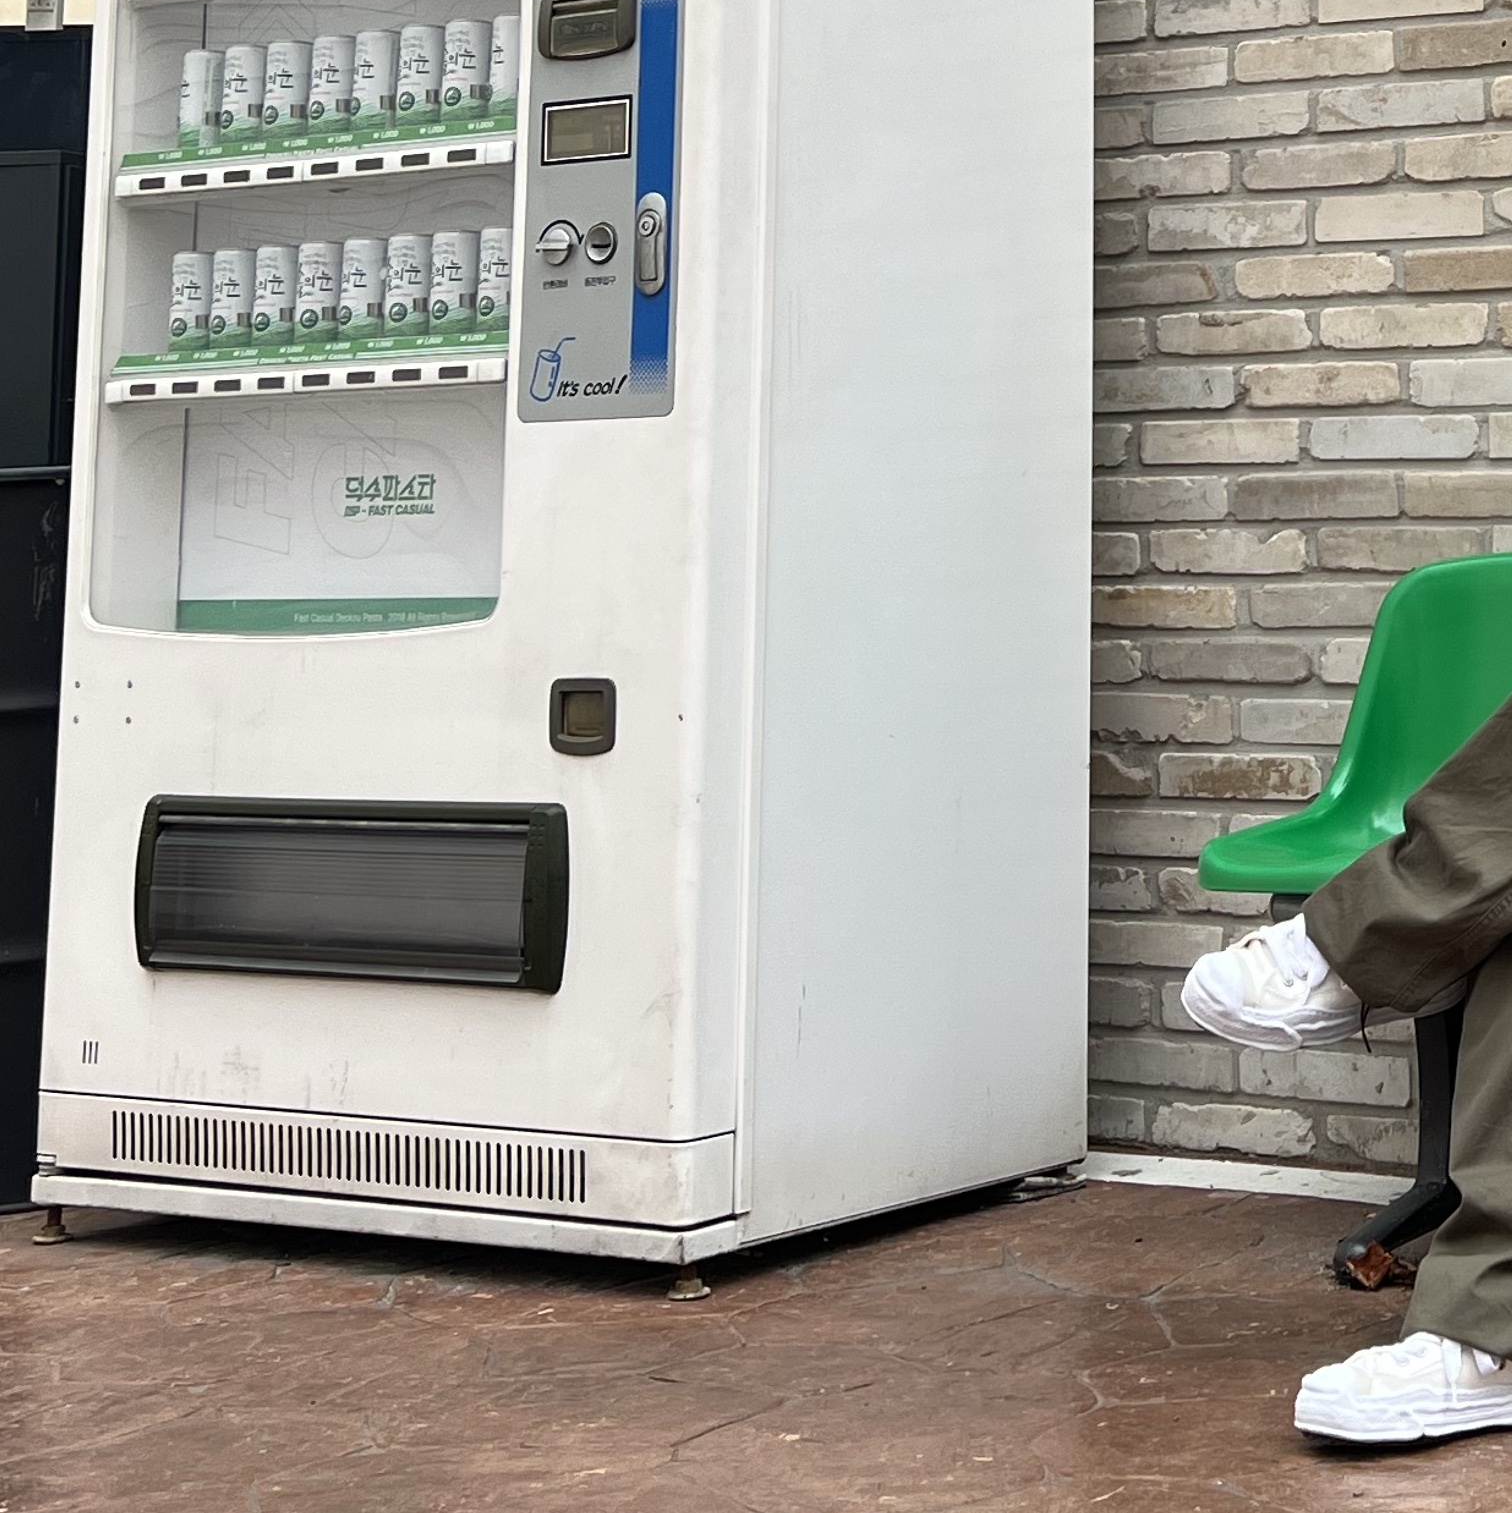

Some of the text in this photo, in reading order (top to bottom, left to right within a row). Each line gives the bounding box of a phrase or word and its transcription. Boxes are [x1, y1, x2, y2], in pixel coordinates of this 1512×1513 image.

[444, 47, 476, 74] 의눈
[557, 374, 628, 397] It's cool!
[368, 505, 394, 516] FAST
[395, 504, 435, 515] CASUAL
